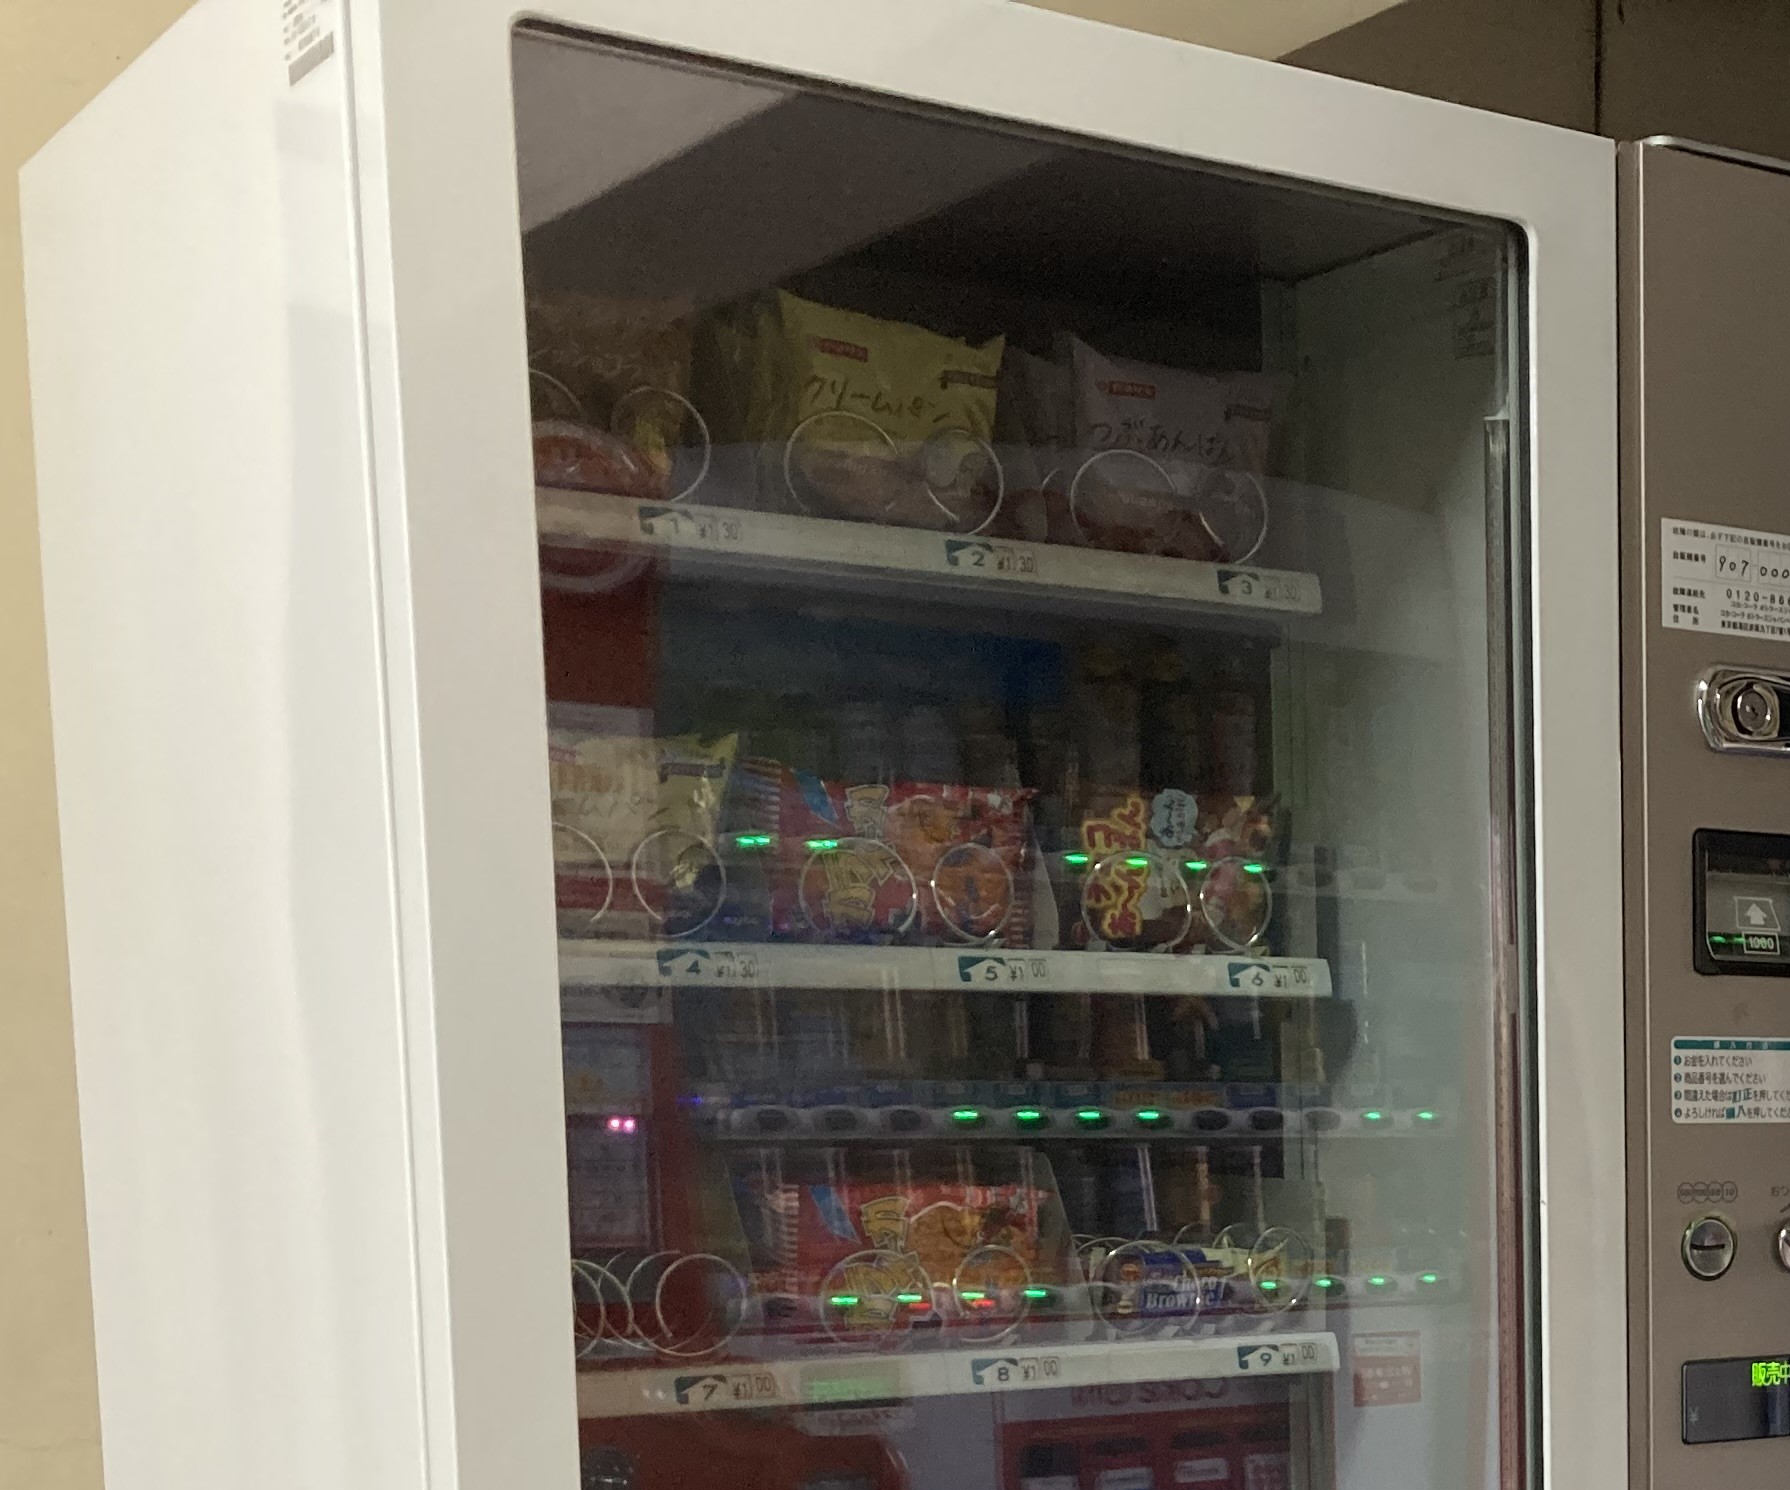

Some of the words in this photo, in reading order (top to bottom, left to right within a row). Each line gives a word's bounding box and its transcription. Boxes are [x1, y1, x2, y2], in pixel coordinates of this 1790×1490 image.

[972, 551, 985, 567] 2
[1719, 556, 1749, 576] 907
[984, 966, 998, 981] 5
[1251, 971, 1264, 986] 6
[1261, 1353, 1272, 1366] 9
[998, 1367, 1009, 1382] 8
[704, 1383, 718, 1401] 7
